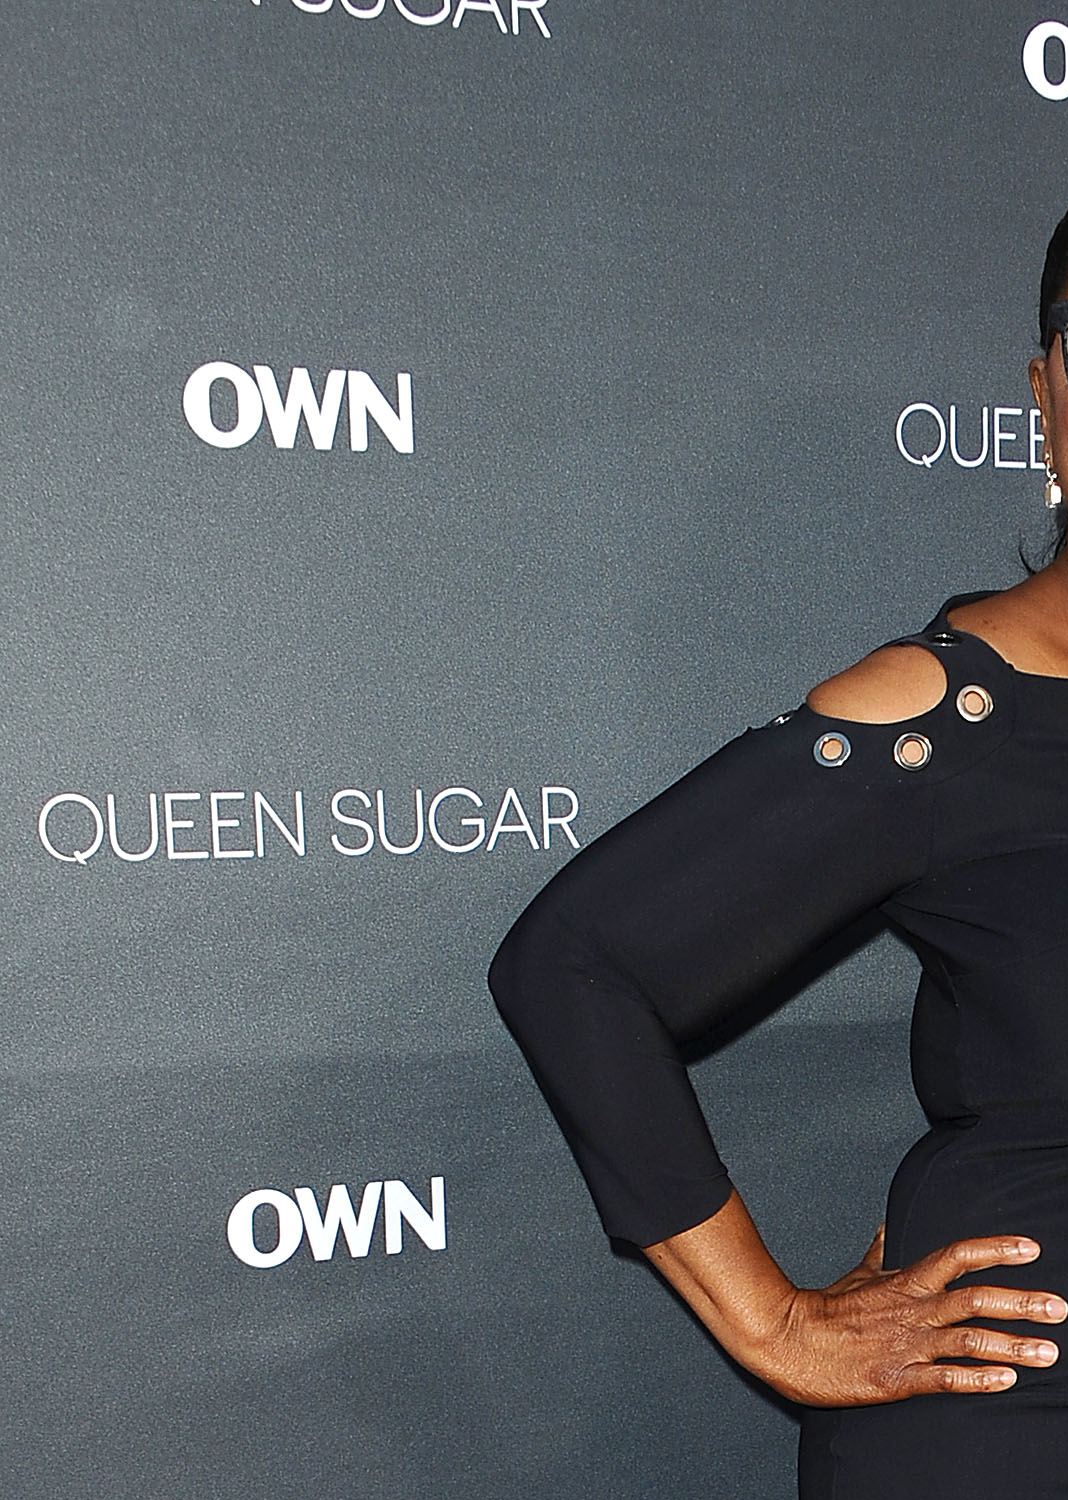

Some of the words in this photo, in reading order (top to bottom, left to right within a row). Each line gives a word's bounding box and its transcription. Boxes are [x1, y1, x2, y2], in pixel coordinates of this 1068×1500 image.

[182, 361, 414, 454] OWN
[38, 790, 305, 866] QUEEN
[331, 786, 581, 856] SUGAR
[227, 1176, 446, 1269] OWN
